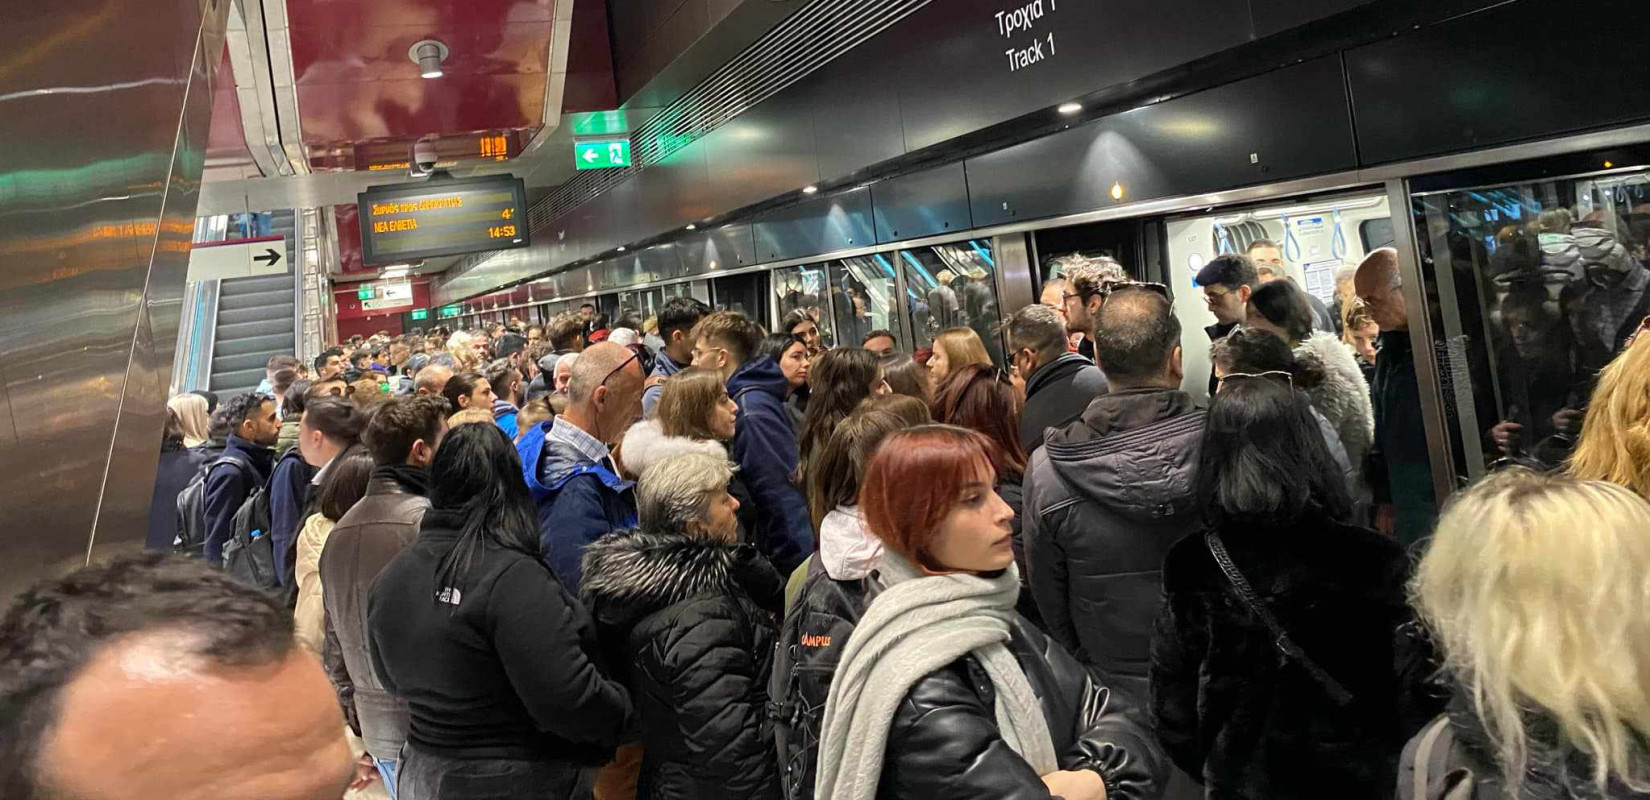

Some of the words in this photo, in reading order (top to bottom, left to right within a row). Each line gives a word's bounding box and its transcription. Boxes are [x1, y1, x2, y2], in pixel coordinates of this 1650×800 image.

[1005, 38, 1045, 72] Track
[1047, 32, 1055, 56] 1
[488, 225, 515, 238] 14:53
[801, 631, 832, 647] CAMPUS
